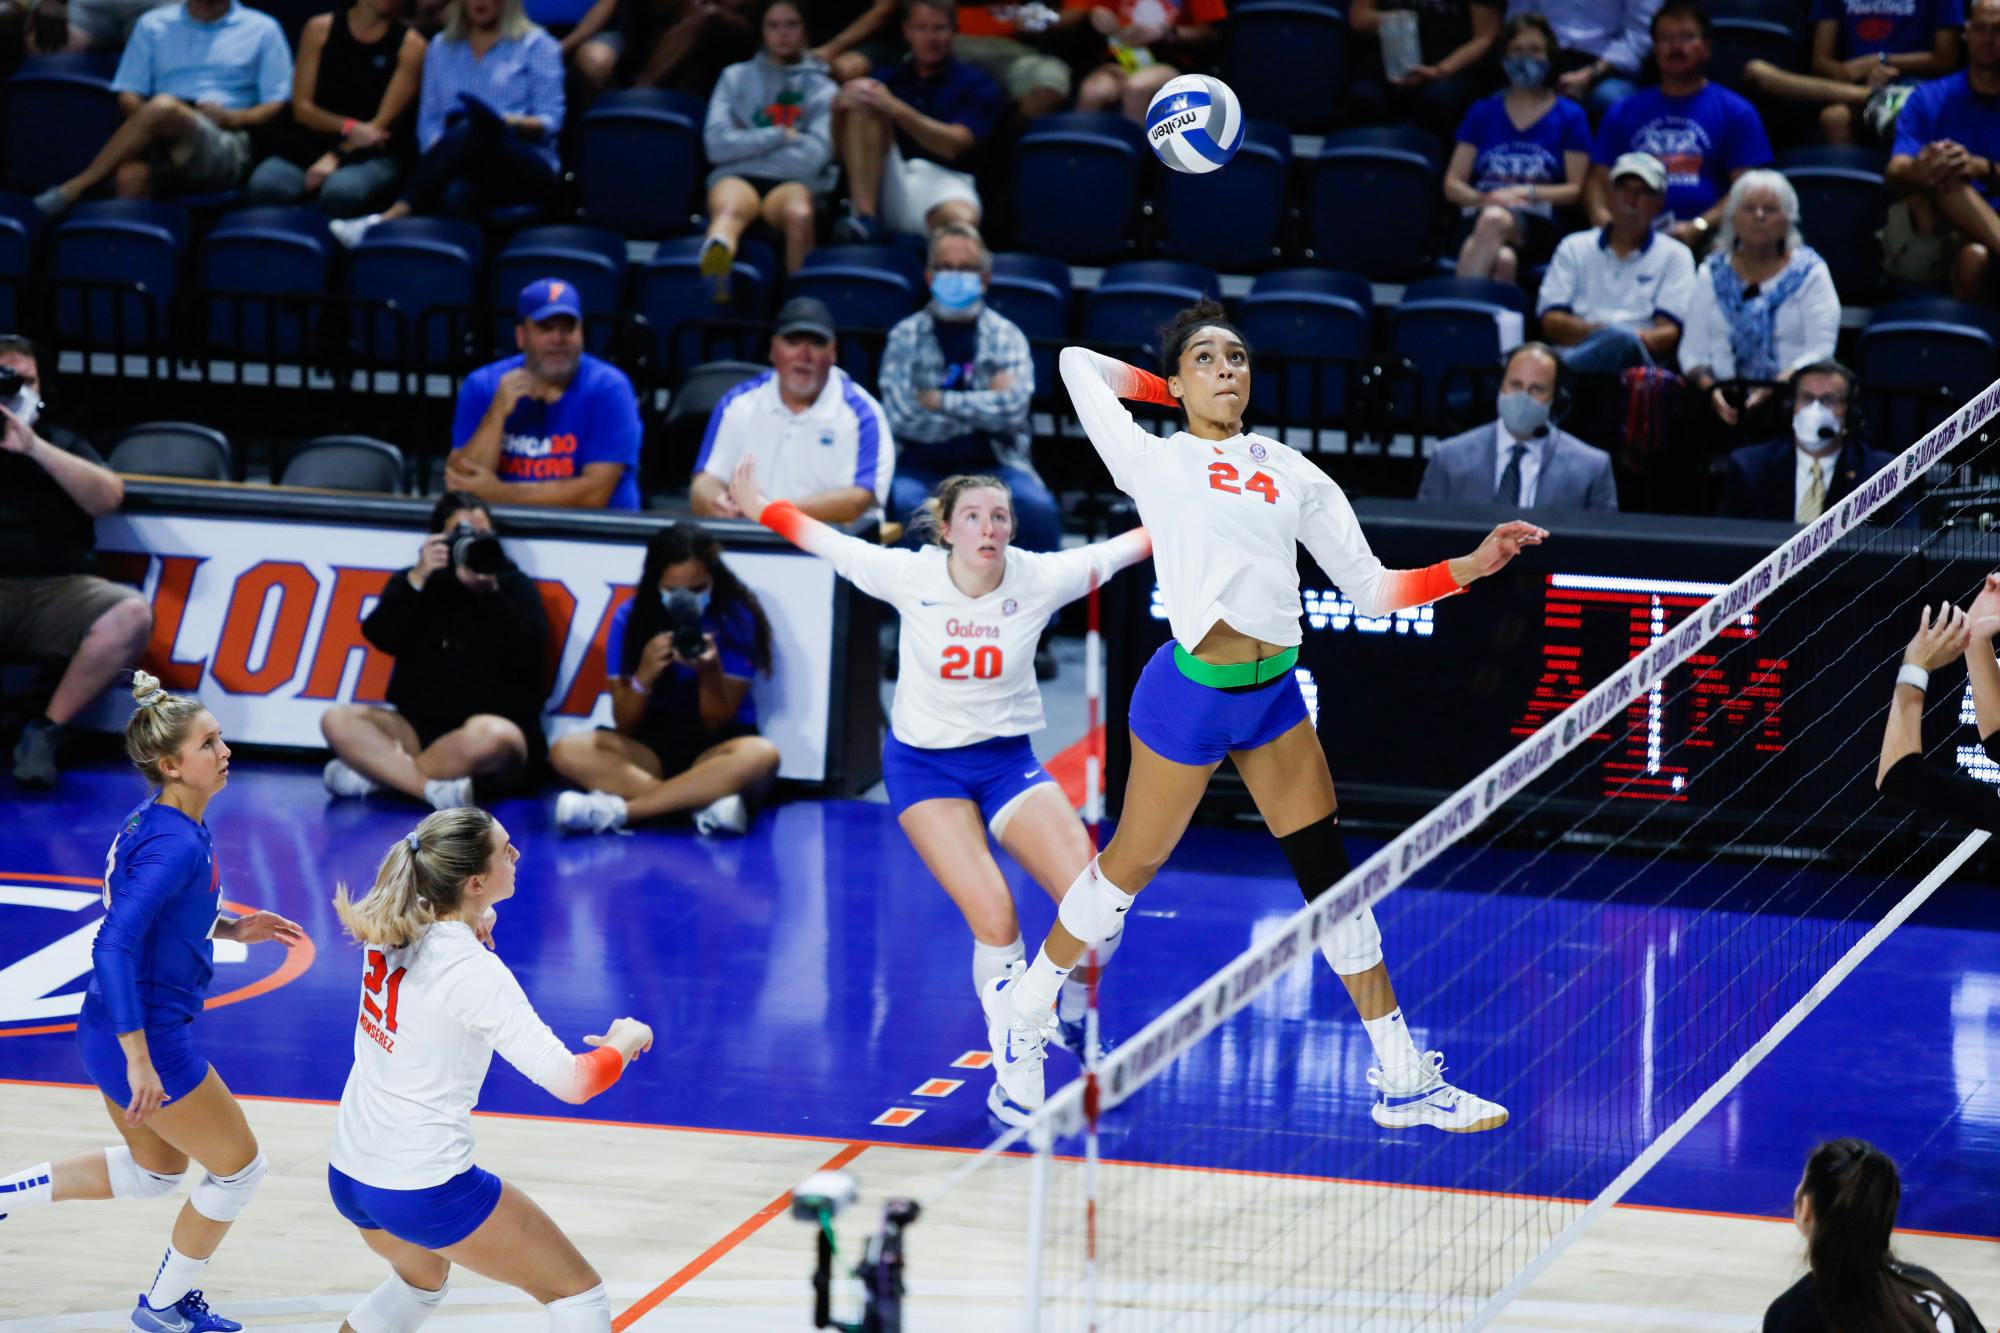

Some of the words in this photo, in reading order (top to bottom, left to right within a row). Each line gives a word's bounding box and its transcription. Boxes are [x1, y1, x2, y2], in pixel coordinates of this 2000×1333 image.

[1151, 111, 1197, 140] molten
[1208, 461, 1280, 505] 24
[946, 618, 1000, 639] Gators
[940, 645, 1003, 680] 20
[364, 949, 407, 1034] 21
